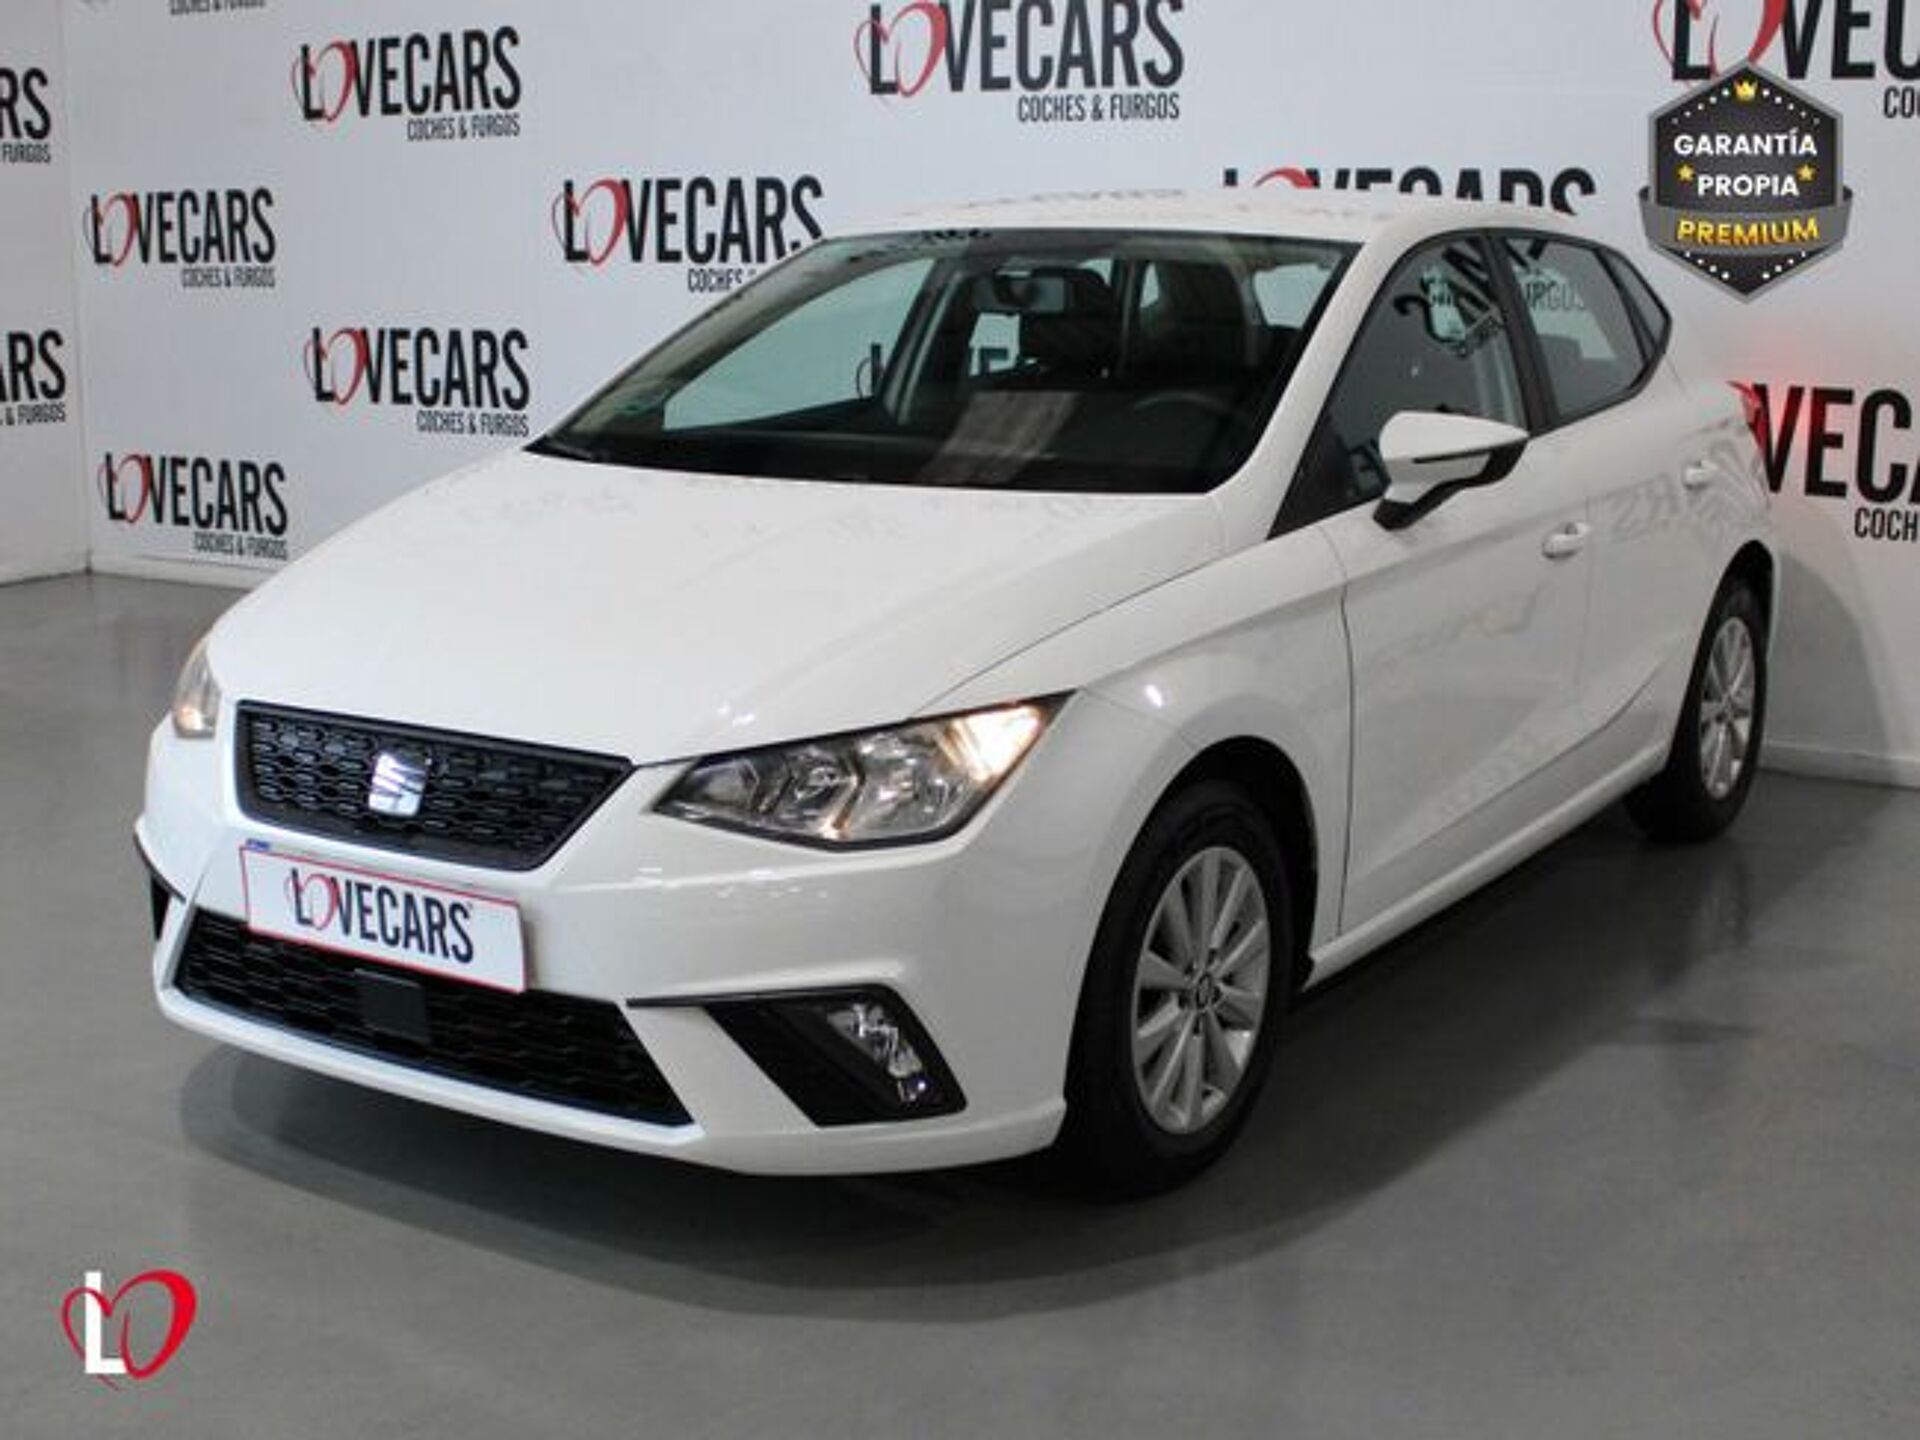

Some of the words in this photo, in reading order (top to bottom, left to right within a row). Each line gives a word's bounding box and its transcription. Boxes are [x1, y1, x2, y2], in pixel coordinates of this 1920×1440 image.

[294, 25, 521, 121] LOVECARS
[857, 0, 1185, 97] LOVECARS
[407, 117, 456, 141] COCHES
[459, 117, 468, 139] &
[471, 113, 521, 137] FURGOS
[1017, 94, 1086, 122] COCHES
[1090, 95, 1104, 119] &
[1109, 93, 1180, 120] FURGOS
[84, 187, 276, 266] LOVECARS
[552, 174, 824, 267] LOVECARS
[0, 329, 66, 402] RS
[303, 327, 530, 411] LOVECARS
[416, 409, 465, 434] COCHES
[468, 413, 477, 434] &
[480, 411, 530, 437] FURGOS
[1728, 380, 1920, 504] VEC
[97, 452, 288, 536] LOVECARS
[285, 867, 475, 964] LOVECARS
